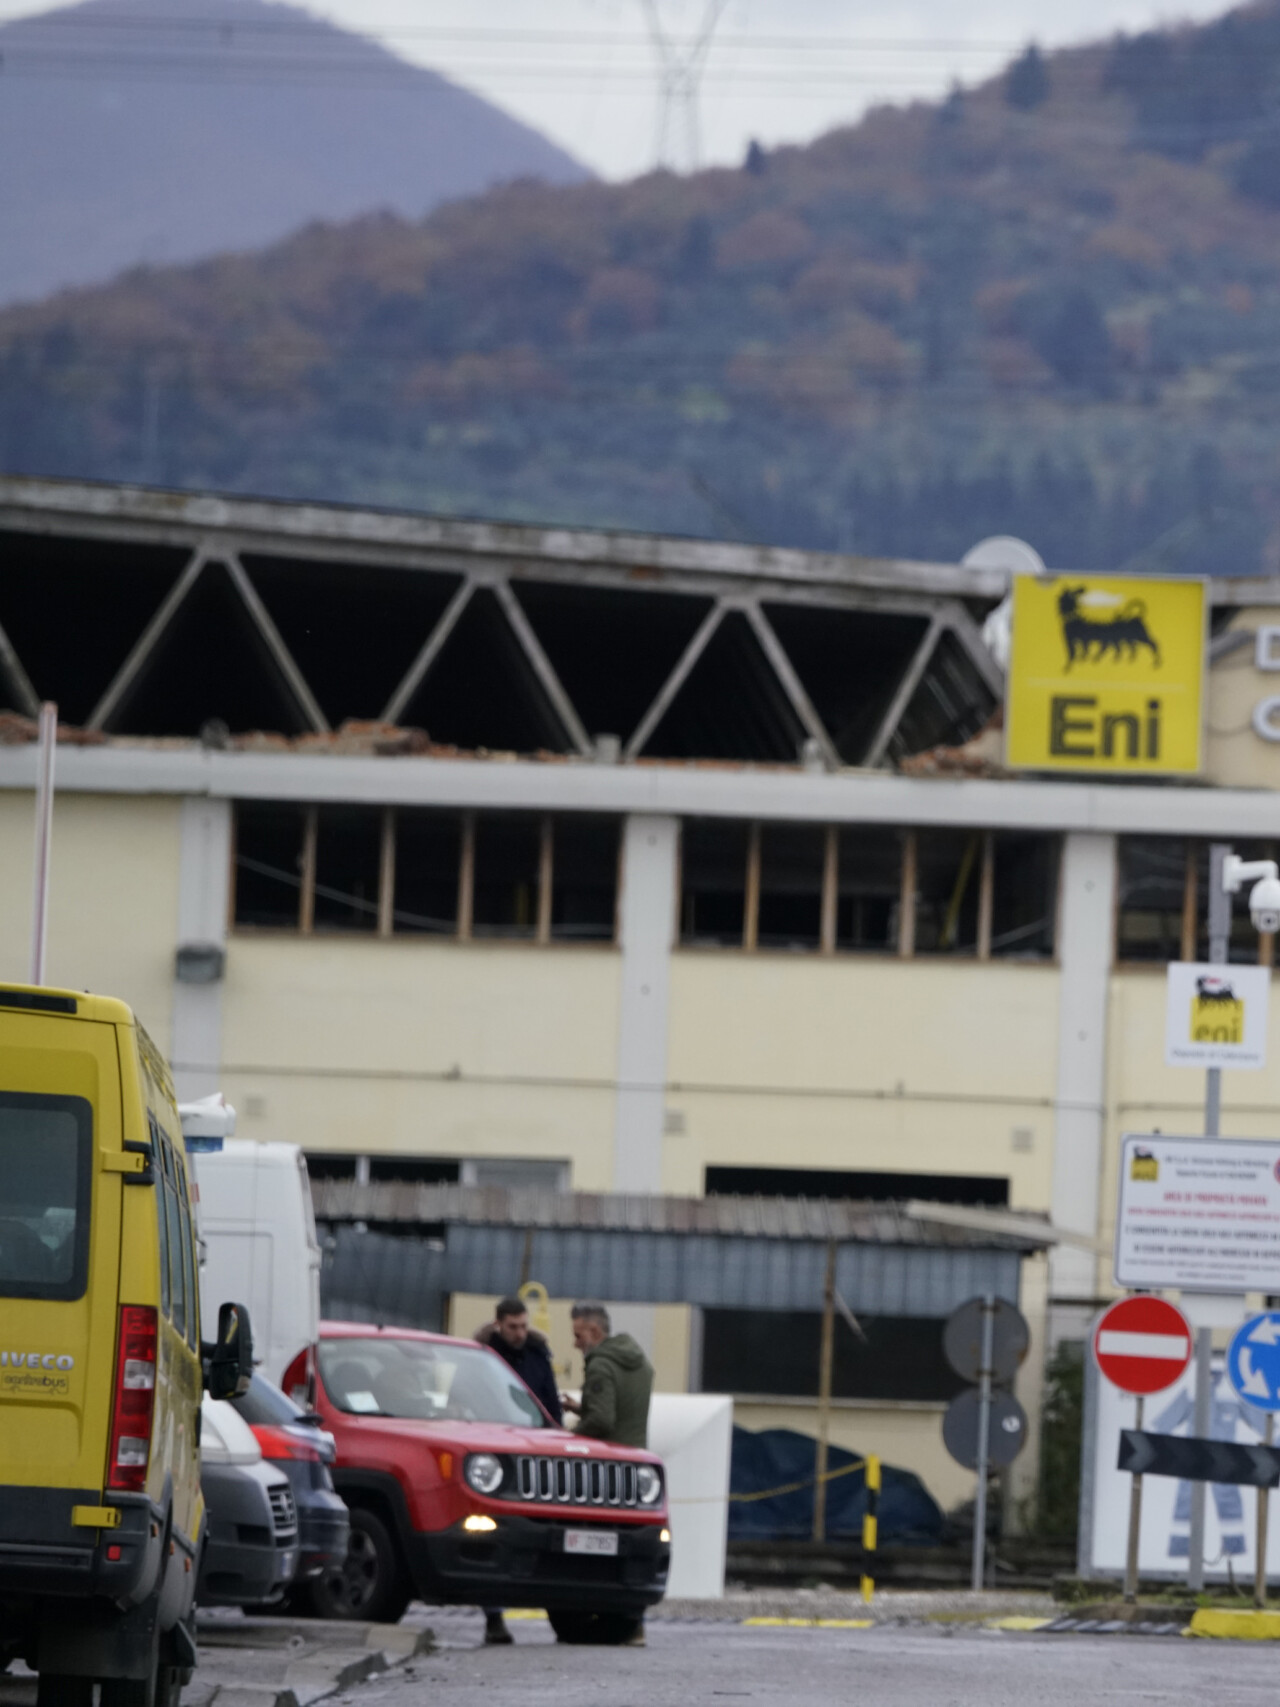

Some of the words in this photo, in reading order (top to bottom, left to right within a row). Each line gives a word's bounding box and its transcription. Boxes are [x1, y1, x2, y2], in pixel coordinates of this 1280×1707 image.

[1049, 694, 1161, 760] Eni
[1194, 1018, 1240, 1043] eni
[1, 1351, 75, 1370] IVECO
